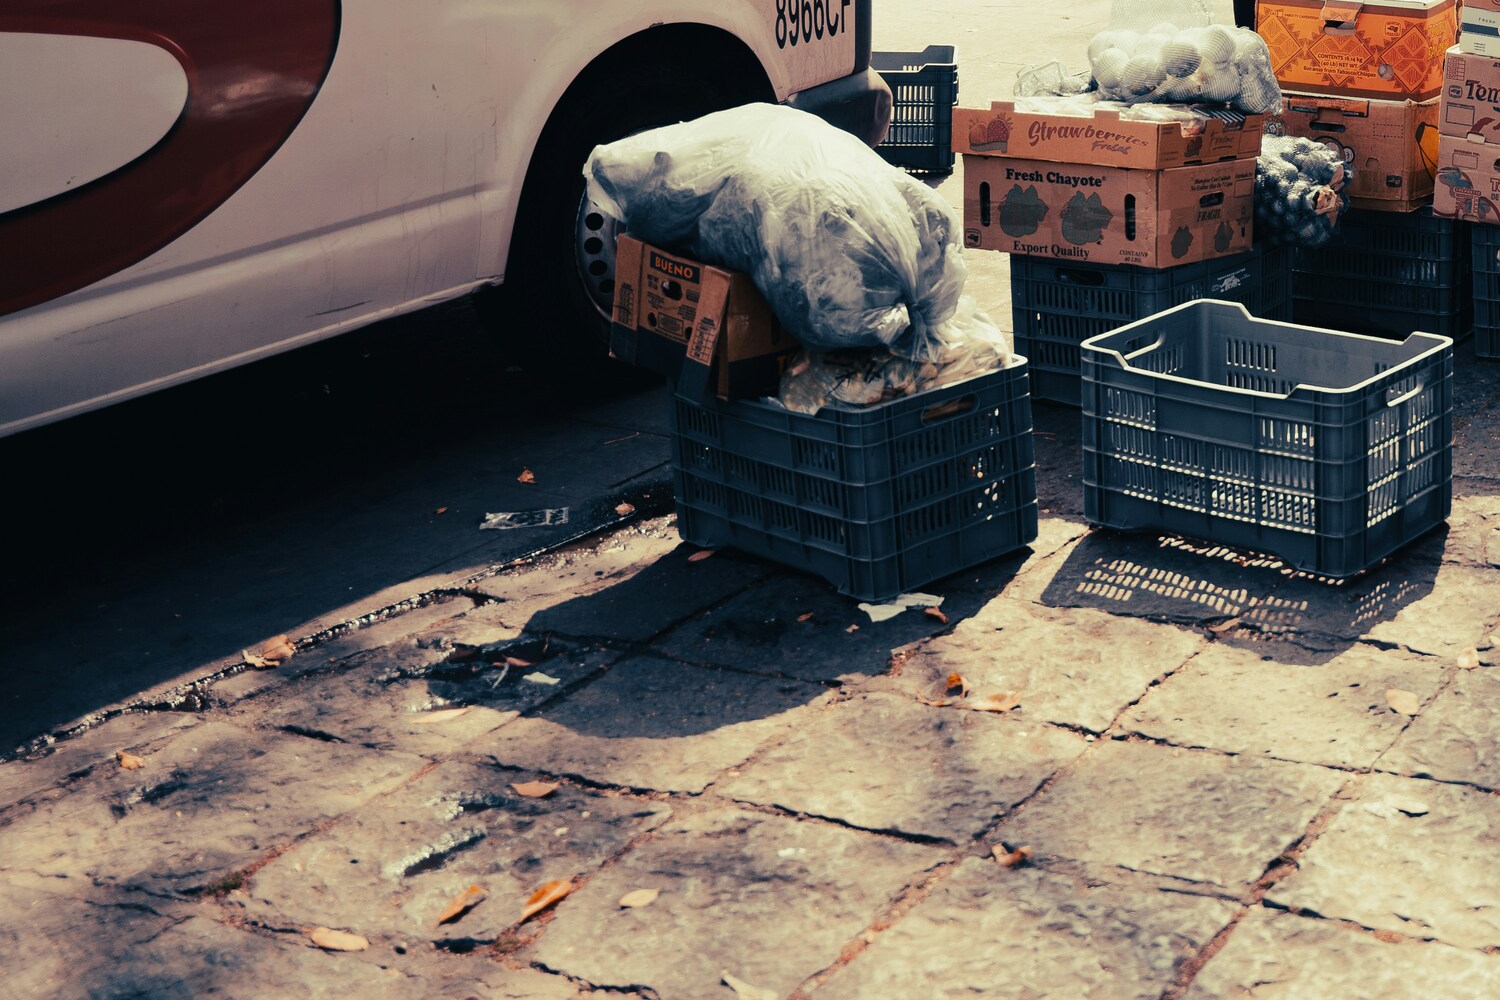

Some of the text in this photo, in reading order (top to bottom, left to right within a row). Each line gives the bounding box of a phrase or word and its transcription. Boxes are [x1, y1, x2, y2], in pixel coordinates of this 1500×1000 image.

[1028, 120, 1149, 147] Strawberries
[1091, 139, 1132, 155] Fresas
[1005, 168, 1103, 188] Fresh Chayote
[1197, 209, 1220, 222] FRAGIL
[1013, 240, 1090, 260] Export Quality
[655, 256, 693, 279] BUENO
